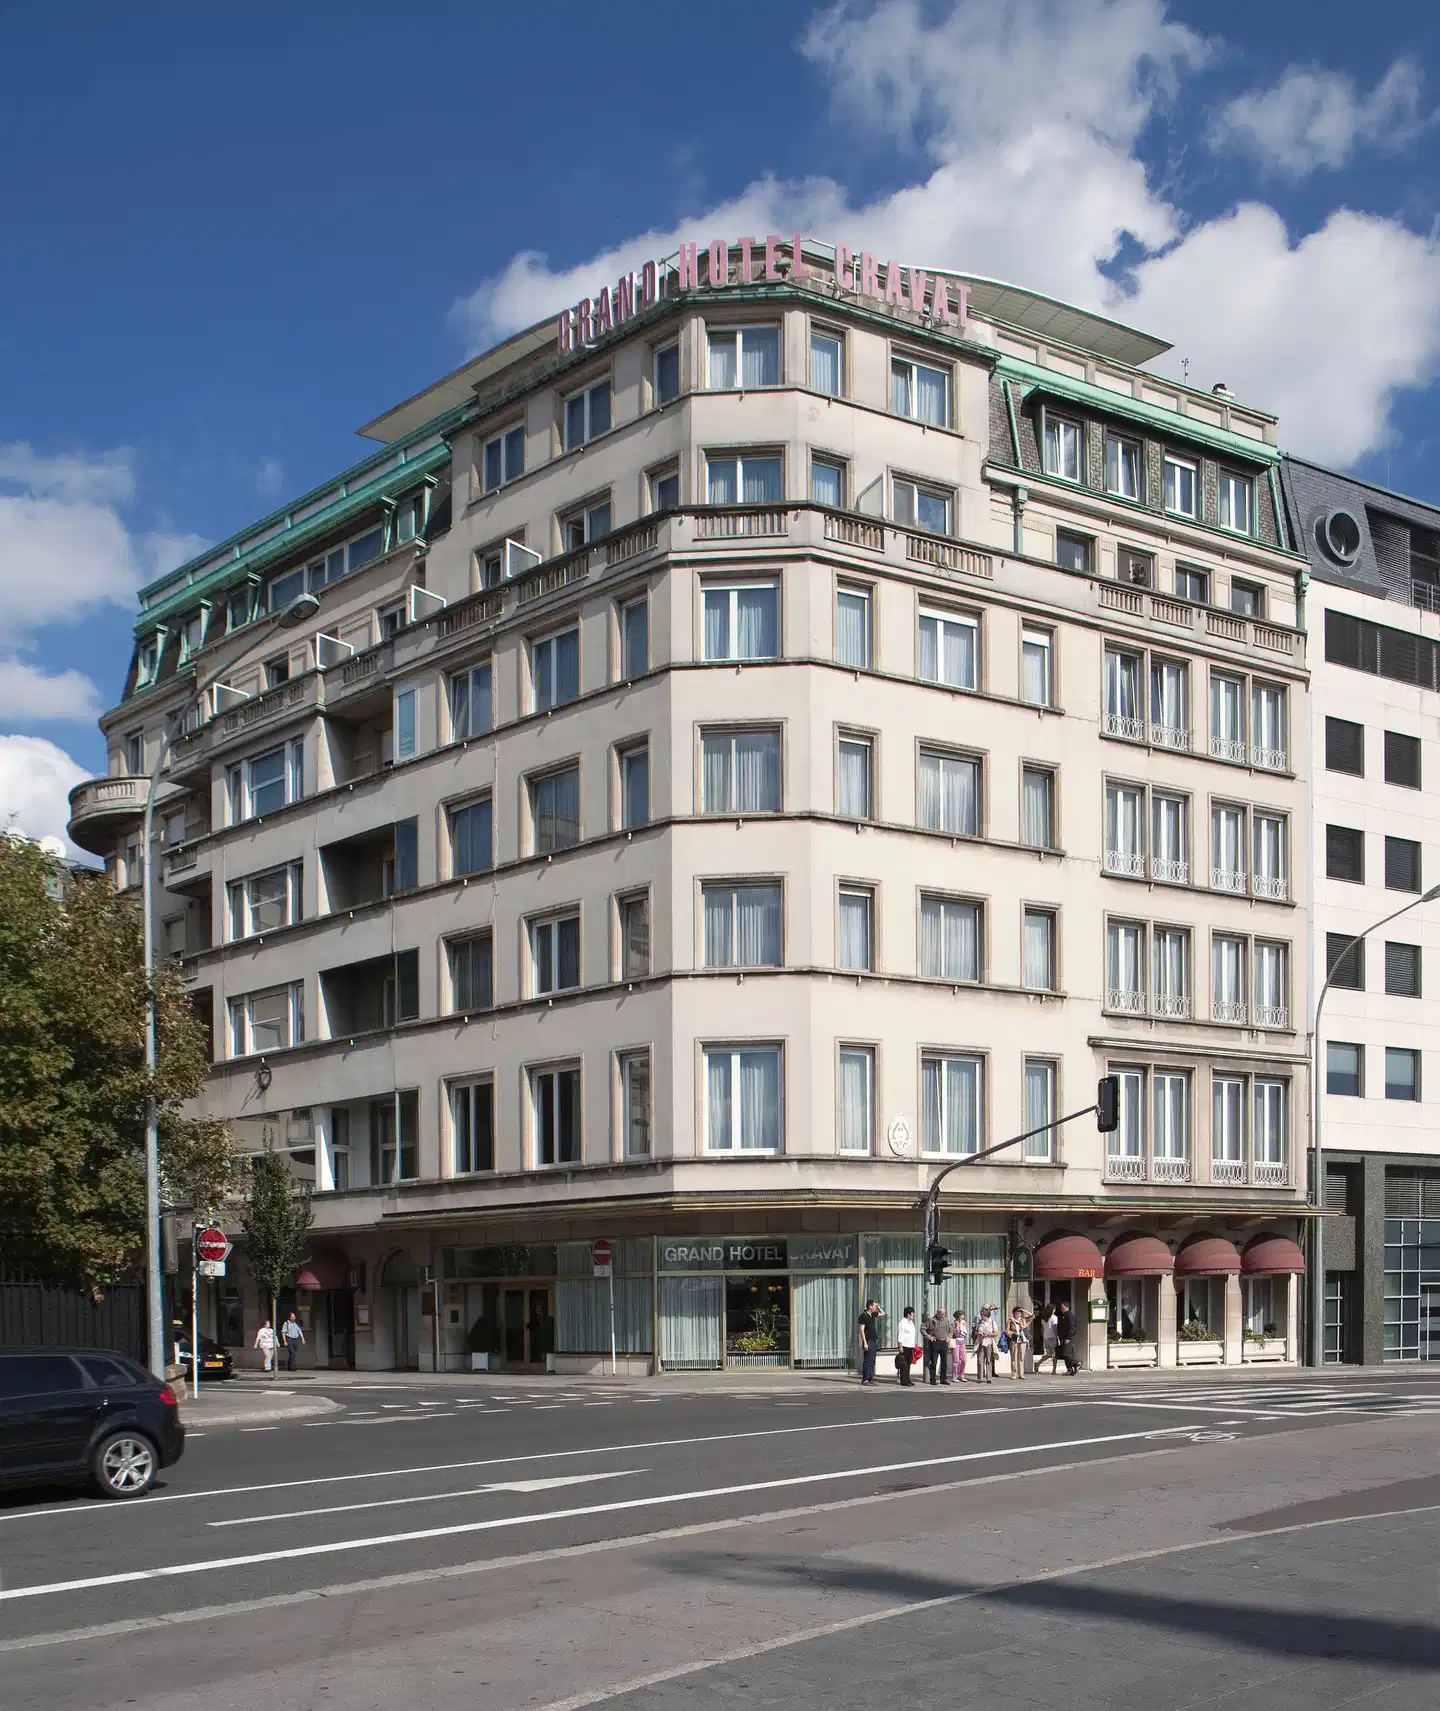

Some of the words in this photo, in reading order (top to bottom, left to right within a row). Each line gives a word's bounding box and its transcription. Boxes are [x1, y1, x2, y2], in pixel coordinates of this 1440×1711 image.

[558, 260, 660, 355] GRAND
[679, 232, 810, 289] HOTEL
[834, 243, 971, 328] CRAVAT
[664, 1246, 724, 1262] GRAND
[730, 1245, 783, 1261] HOTEL
[789, 1244, 852, 1260] AVAT
[1078, 1269, 1096, 1277] BAR
